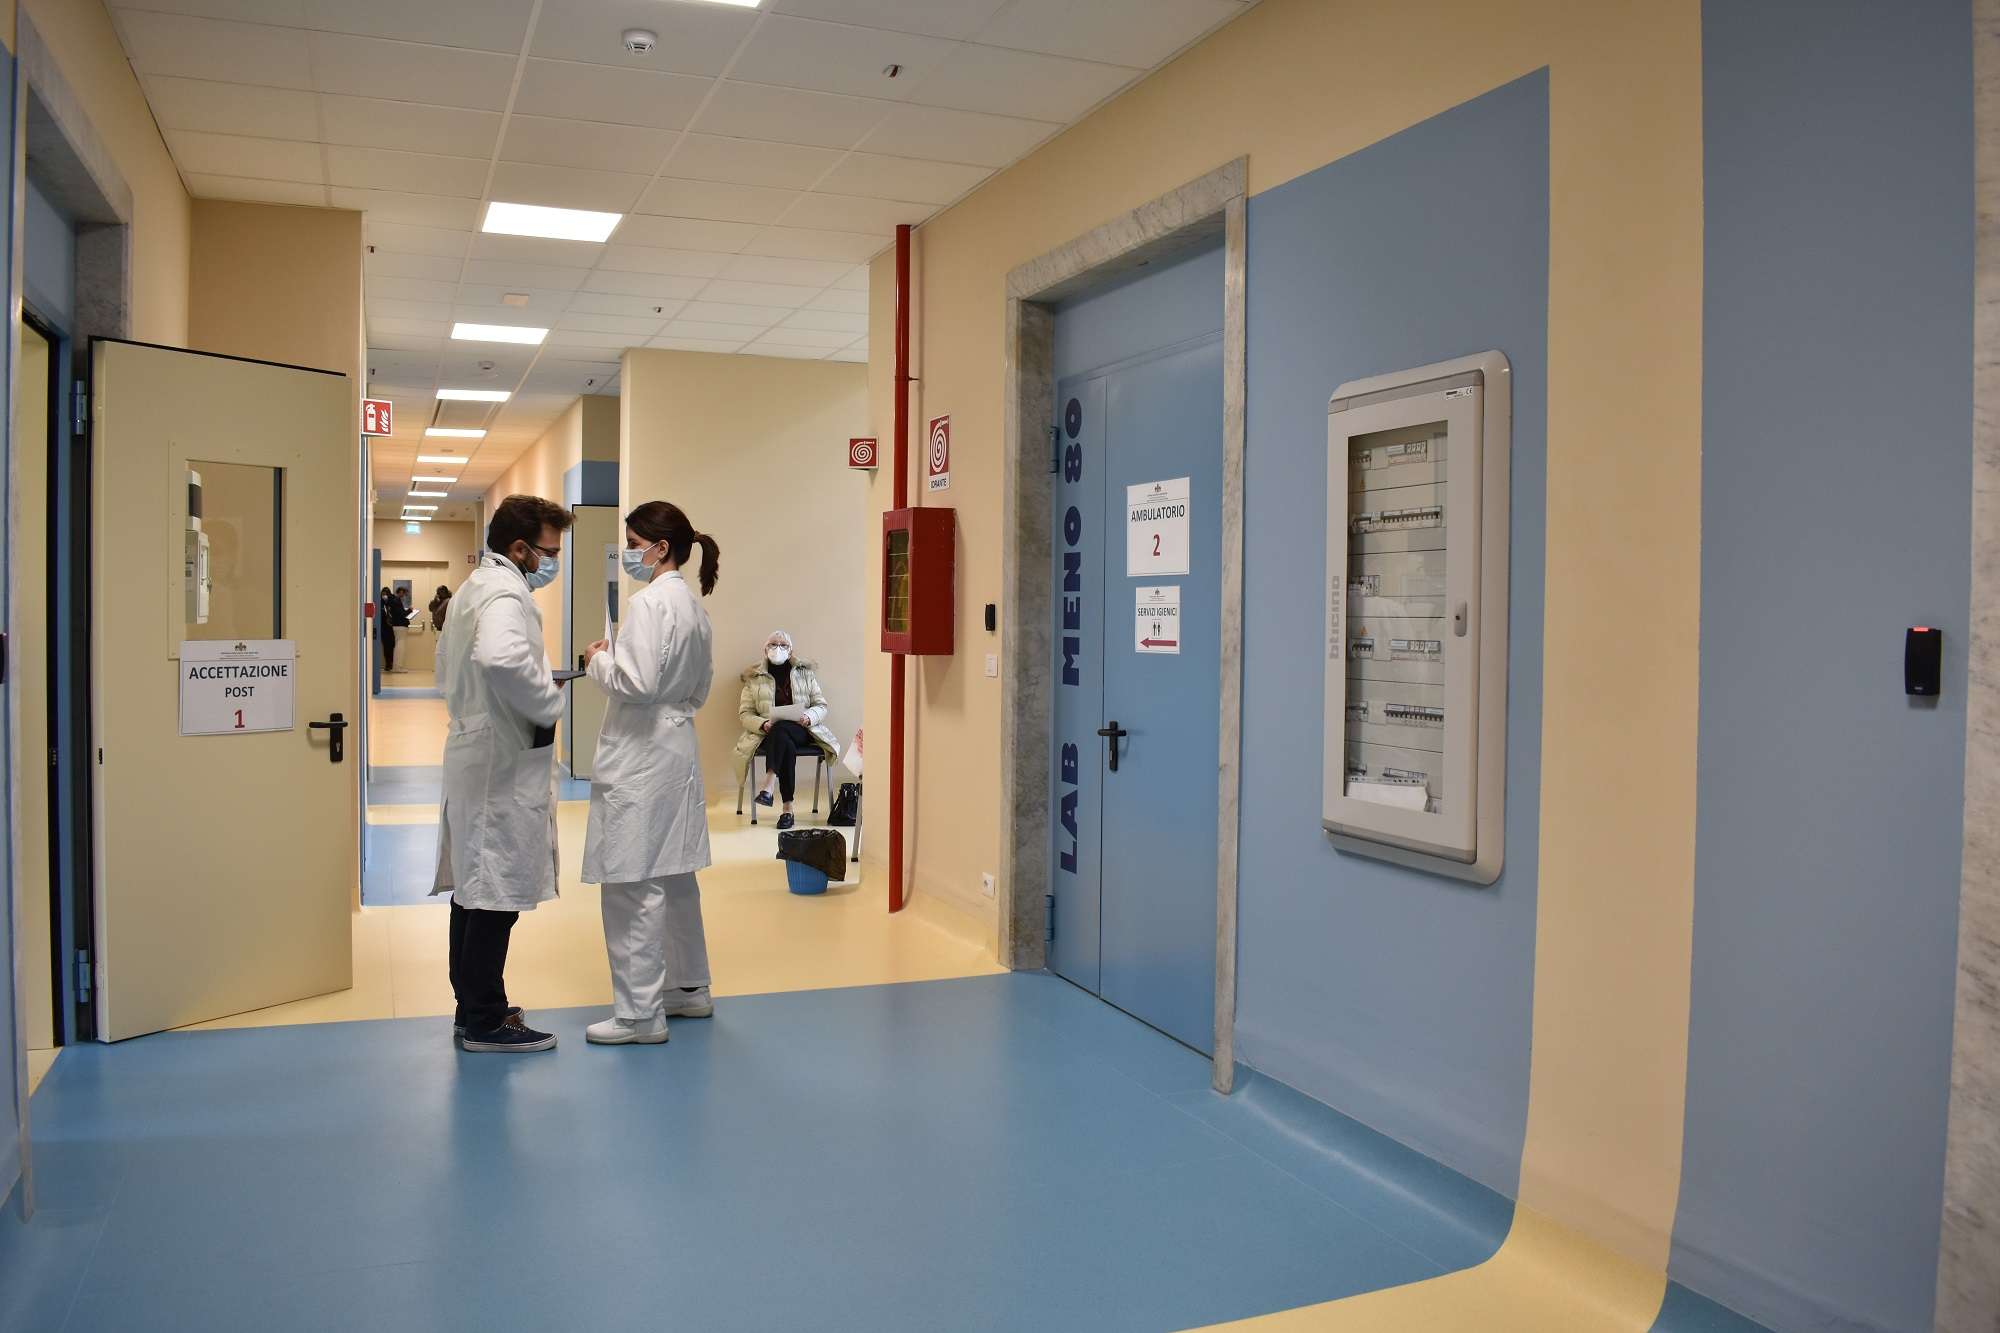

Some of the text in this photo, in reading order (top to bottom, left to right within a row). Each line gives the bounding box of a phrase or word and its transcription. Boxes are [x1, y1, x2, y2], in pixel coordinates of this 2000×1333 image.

[1131, 504, 1185, 522] AMBULATORIO
[1153, 534, 1161, 557] 2
[1137, 607, 1178, 617] SERVIZI IGIENICI
[1060, 398, 1082, 875] LAB MENO 80
[189, 665, 288, 679] ACCETTAZIONE
[225, 686, 255, 698] POST
[234, 709, 245, 729] 1
